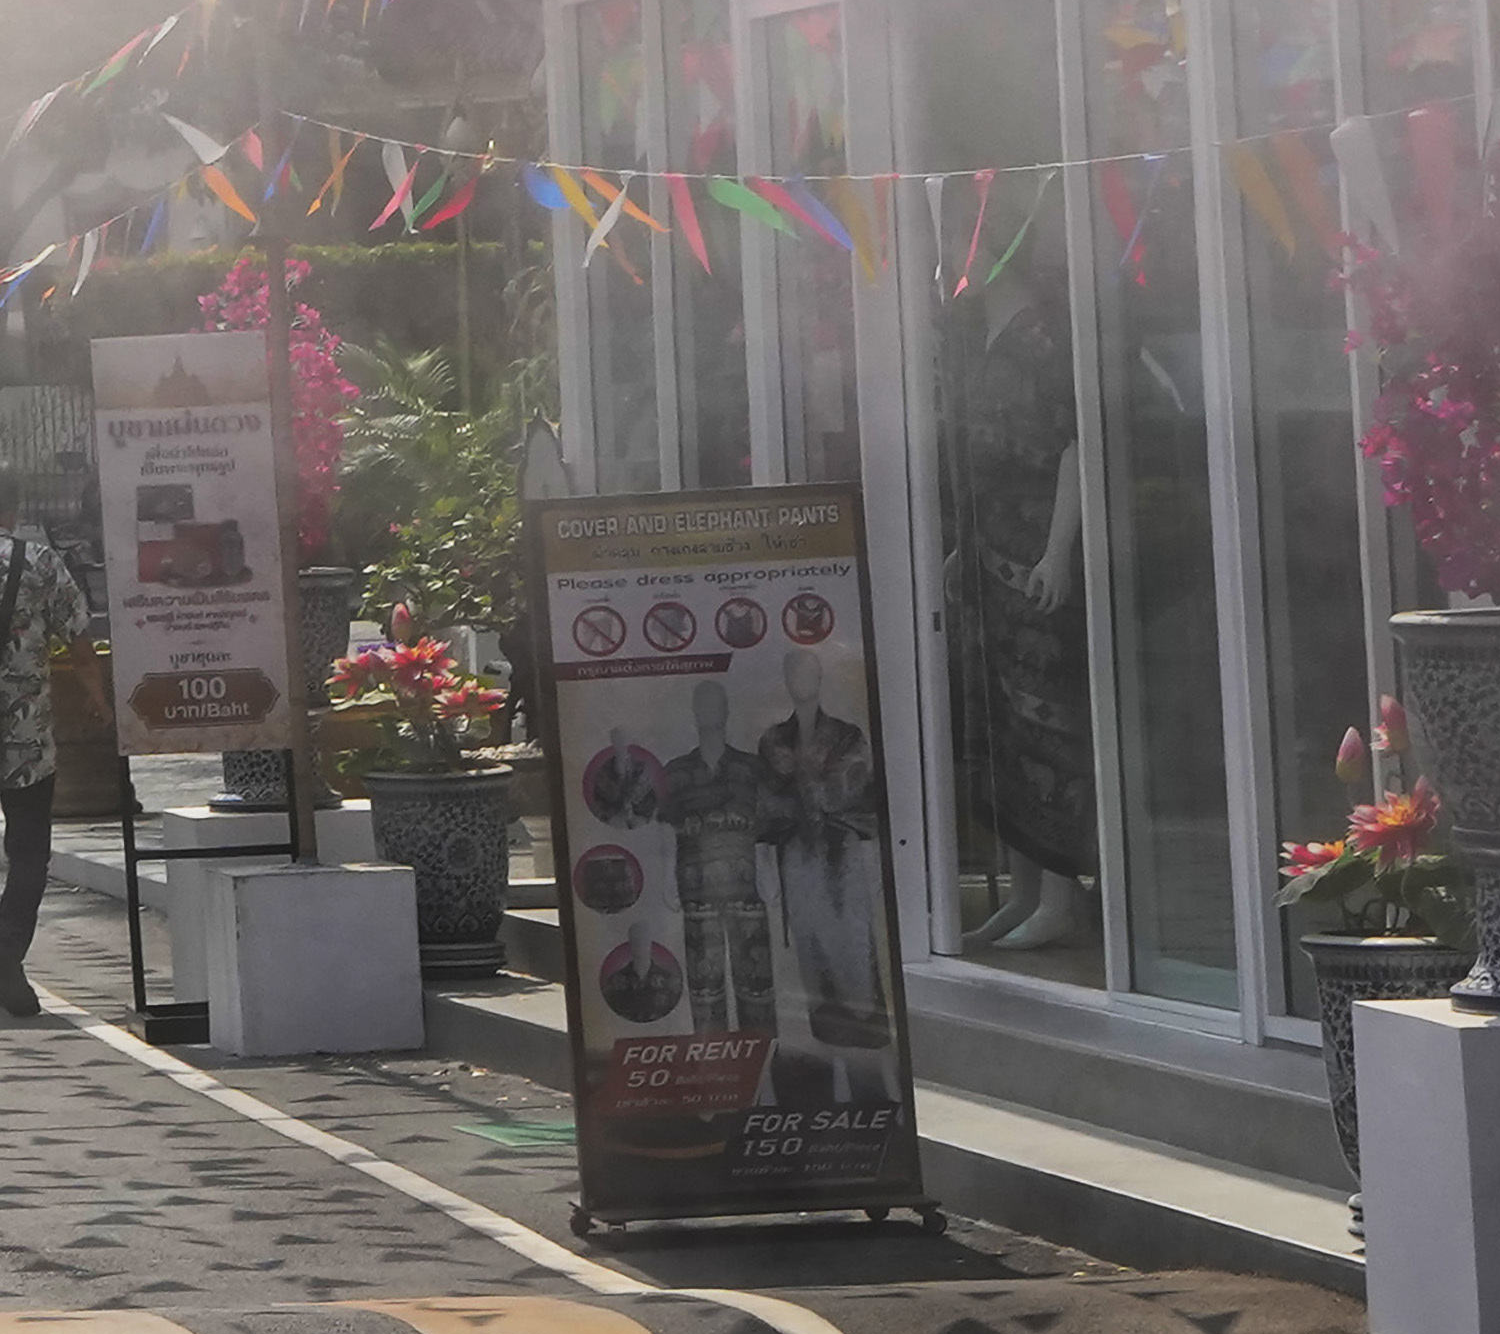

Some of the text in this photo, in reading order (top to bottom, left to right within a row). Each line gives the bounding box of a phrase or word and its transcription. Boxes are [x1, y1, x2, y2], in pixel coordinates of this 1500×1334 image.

[557, 505, 840, 539] COVER AND ELEPHANT PANTS
[558, 563, 852, 590] Please dress appropriately
[178, 676, 226, 700] 100
[164, 702, 250, 720] บาท/Baht
[622, 1039, 760, 1065] FOR RENT
[627, 1068, 671, 1088] 50
[743, 1109, 892, 1134] FOR SALE
[743, 1137, 803, 1156] 150
